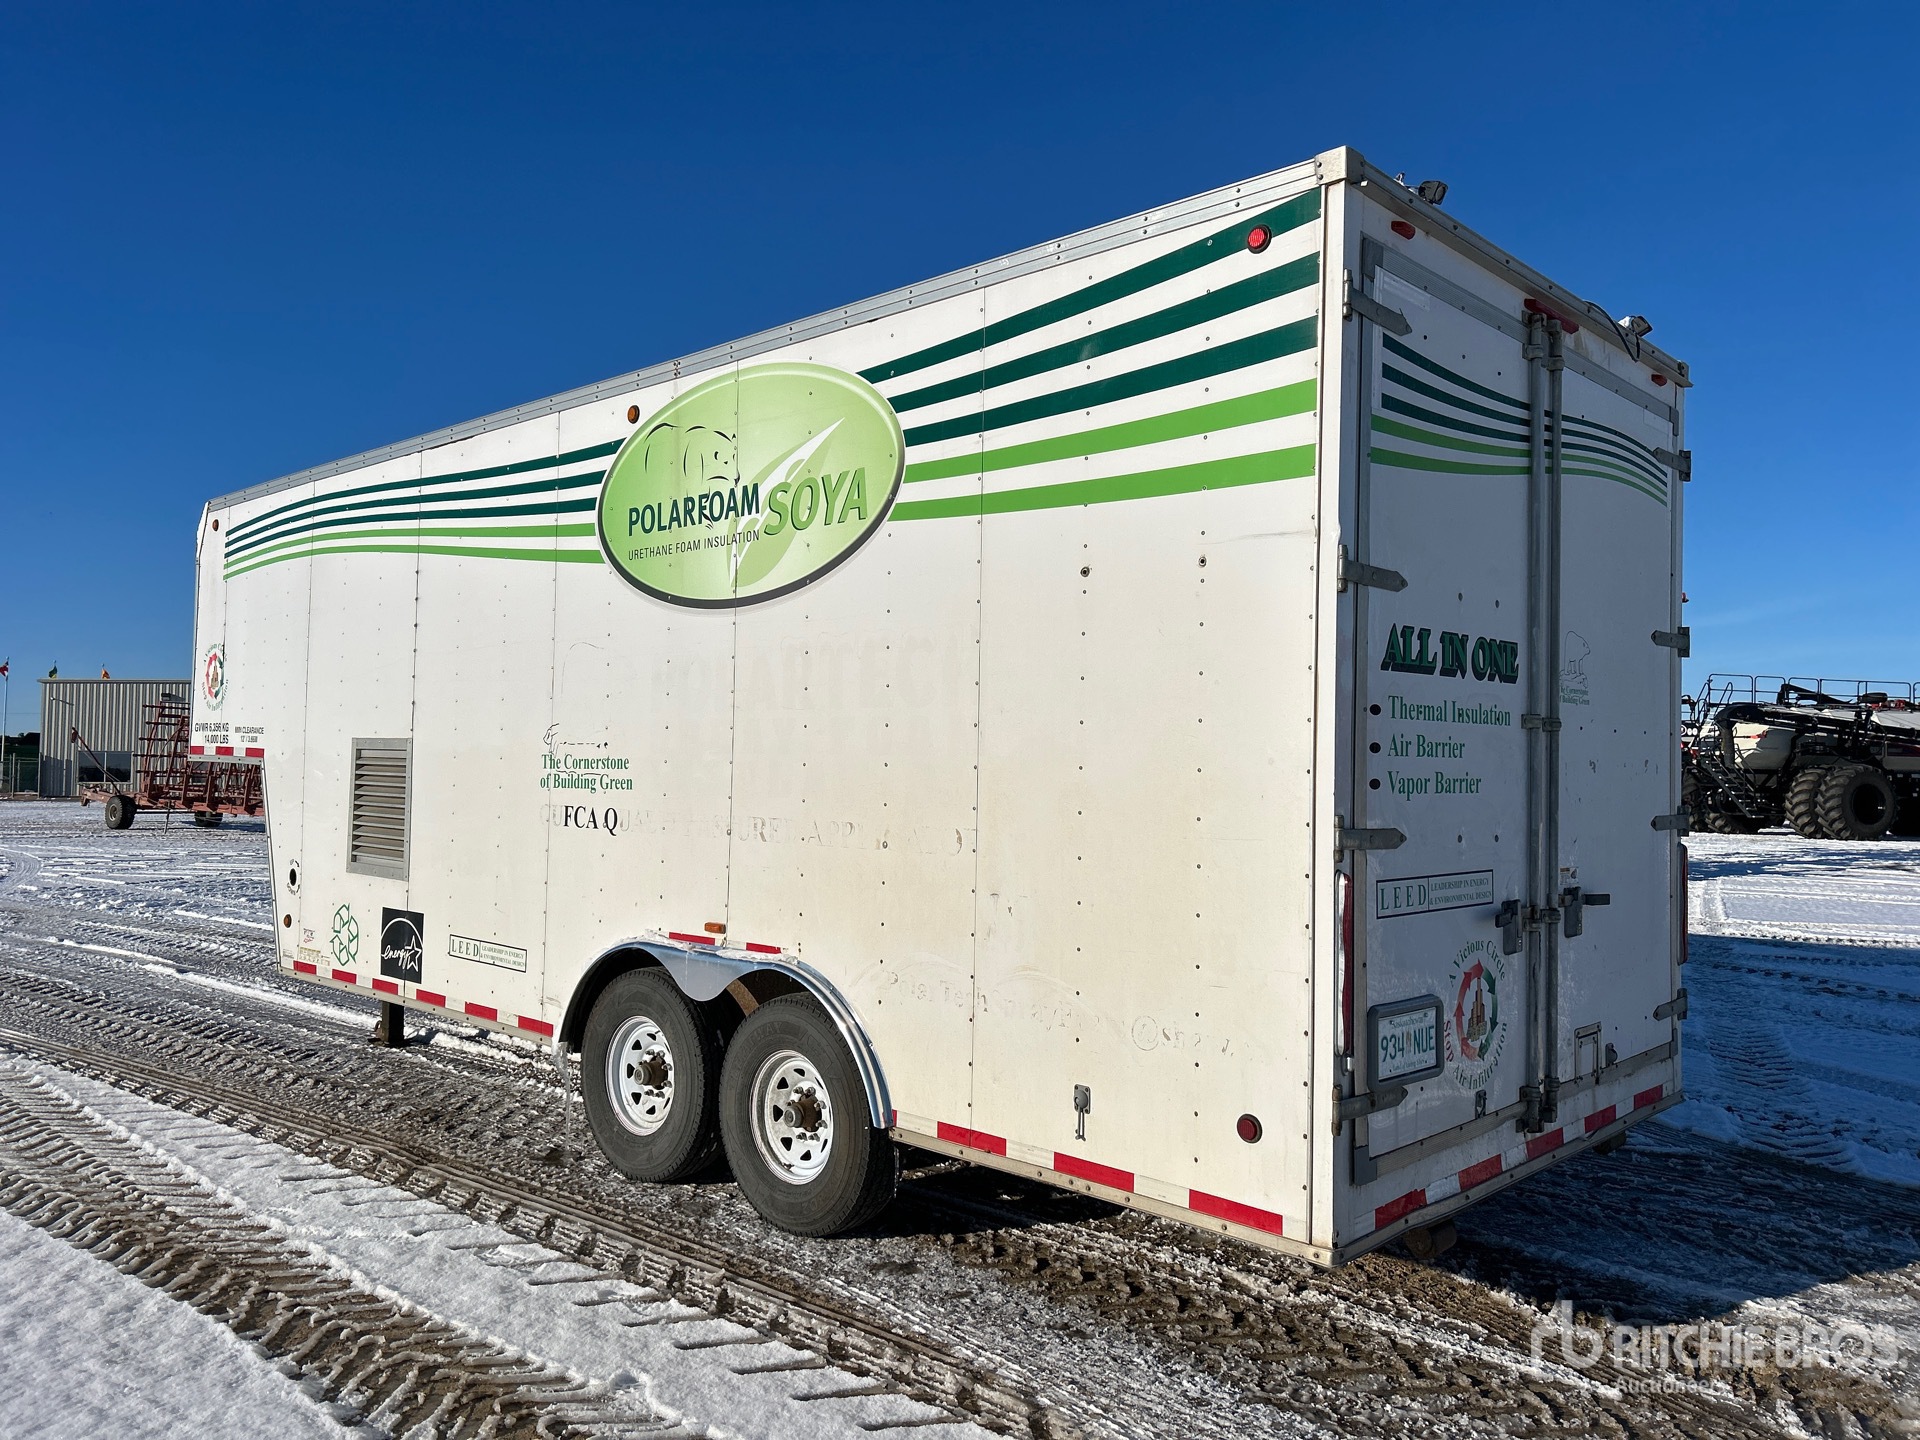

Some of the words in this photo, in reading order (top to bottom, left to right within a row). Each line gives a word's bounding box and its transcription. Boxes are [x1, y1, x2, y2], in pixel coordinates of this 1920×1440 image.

[628, 482, 760, 537] POLARFOAM
[763, 467, 869, 536] SOYA
[628, 543, 673, 561] URETHANE
[675, 538, 701, 554] FOAM
[704, 529, 760, 549] INSULATION
[1380, 622, 1438, 676] ALL
[1439, 631, 1469, 679] IN
[1471, 636, 1519, 684] ONE
[1388, 695, 1447, 723] Thermal
[1451, 700, 1511, 727] Insulation
[219, 734, 229, 744] LBS
[1387, 733, 1412, 758] Air
[1416, 734, 1465, 759] Barrier
[541, 753, 561, 770] The
[564, 753, 630, 770] Cornerstone
[540, 773, 551, 789] of
[553, 773, 597, 794] Building
[599, 774, 633, 791] Green
[1387, 770, 1431, 801] Vapor
[1434, 771, 1482, 794] Barrier
[1380, 884, 1427, 911] LEED
[1430, 880, 1463, 892] LEADERSHIP
[1463, 879, 1470, 888] IN
[1470, 877, 1489, 888] ENERGY
[1434, 893, 1475, 905] ENVIRONMENTAL
[1475, 890, 1492, 900] DESIGN
[452, 939, 479, 957] LEED
[481, 945, 504, 955] LEADERSHIP
[508, 949, 524, 960] ENERGY
[1452, 940, 1484, 969] Vicious
[1486, 940, 1505, 982] Circle
[1448, 973, 1457, 988] A
[1381, 1031, 1404, 1062] 934
[1413, 1025, 1435, 1055] NUE
[1444, 1020, 1455, 1063] Stop
[1452, 1064, 1468, 1087] Air
[1468, 1022, 1507, 1090] Infiltration
